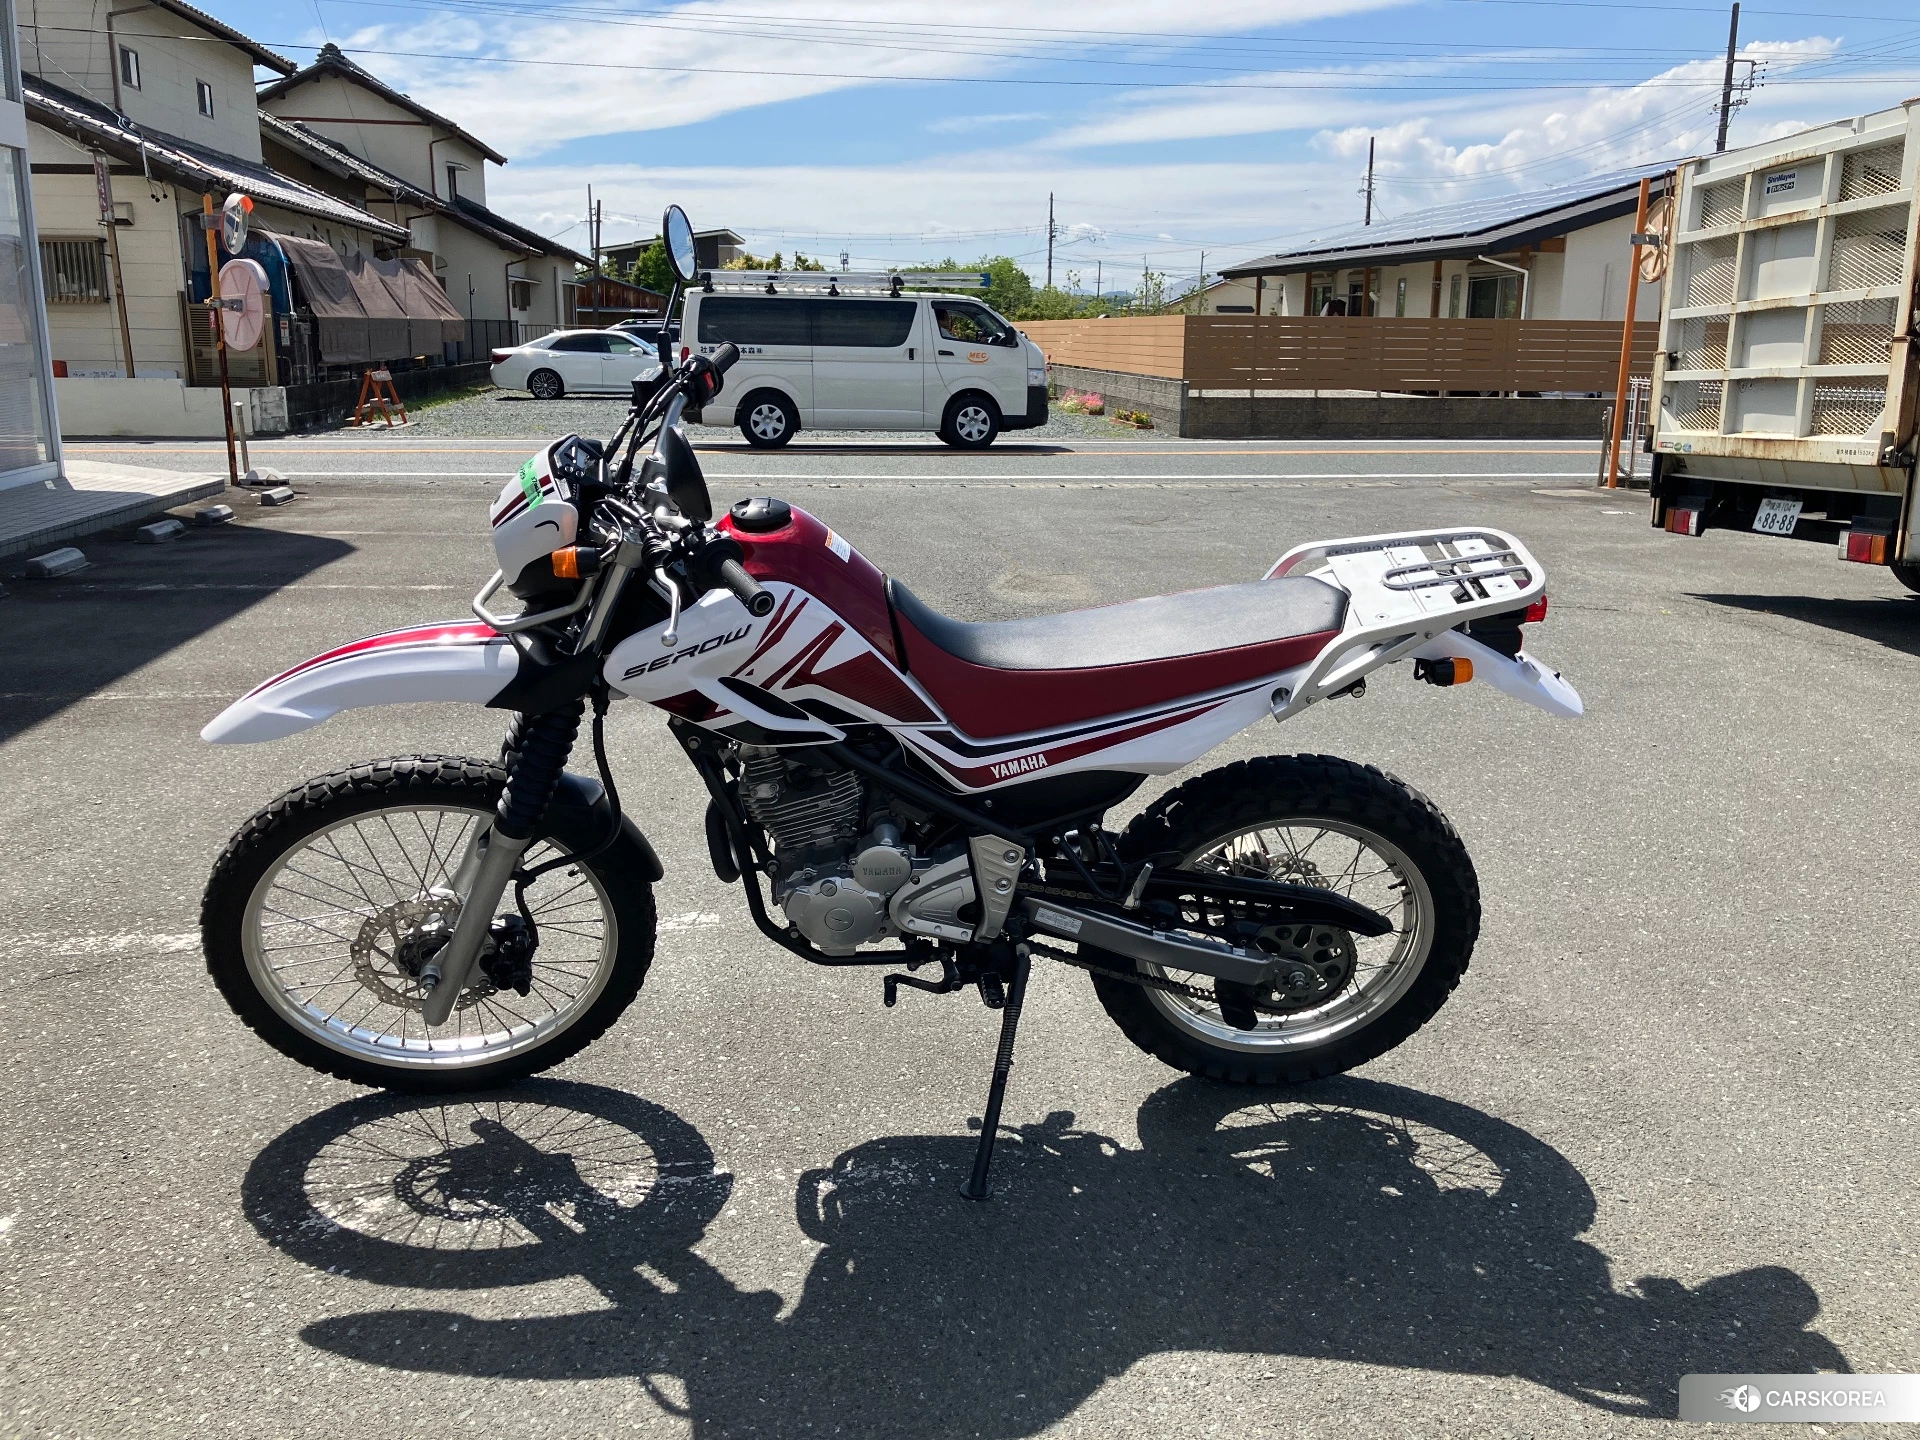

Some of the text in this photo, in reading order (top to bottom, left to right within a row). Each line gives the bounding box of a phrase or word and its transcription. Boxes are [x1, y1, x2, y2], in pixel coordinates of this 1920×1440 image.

[620, 623, 752, 681] SEROW
[990, 753, 1048, 779] YAMAHA
[862, 867, 902, 876] YAMAHA
